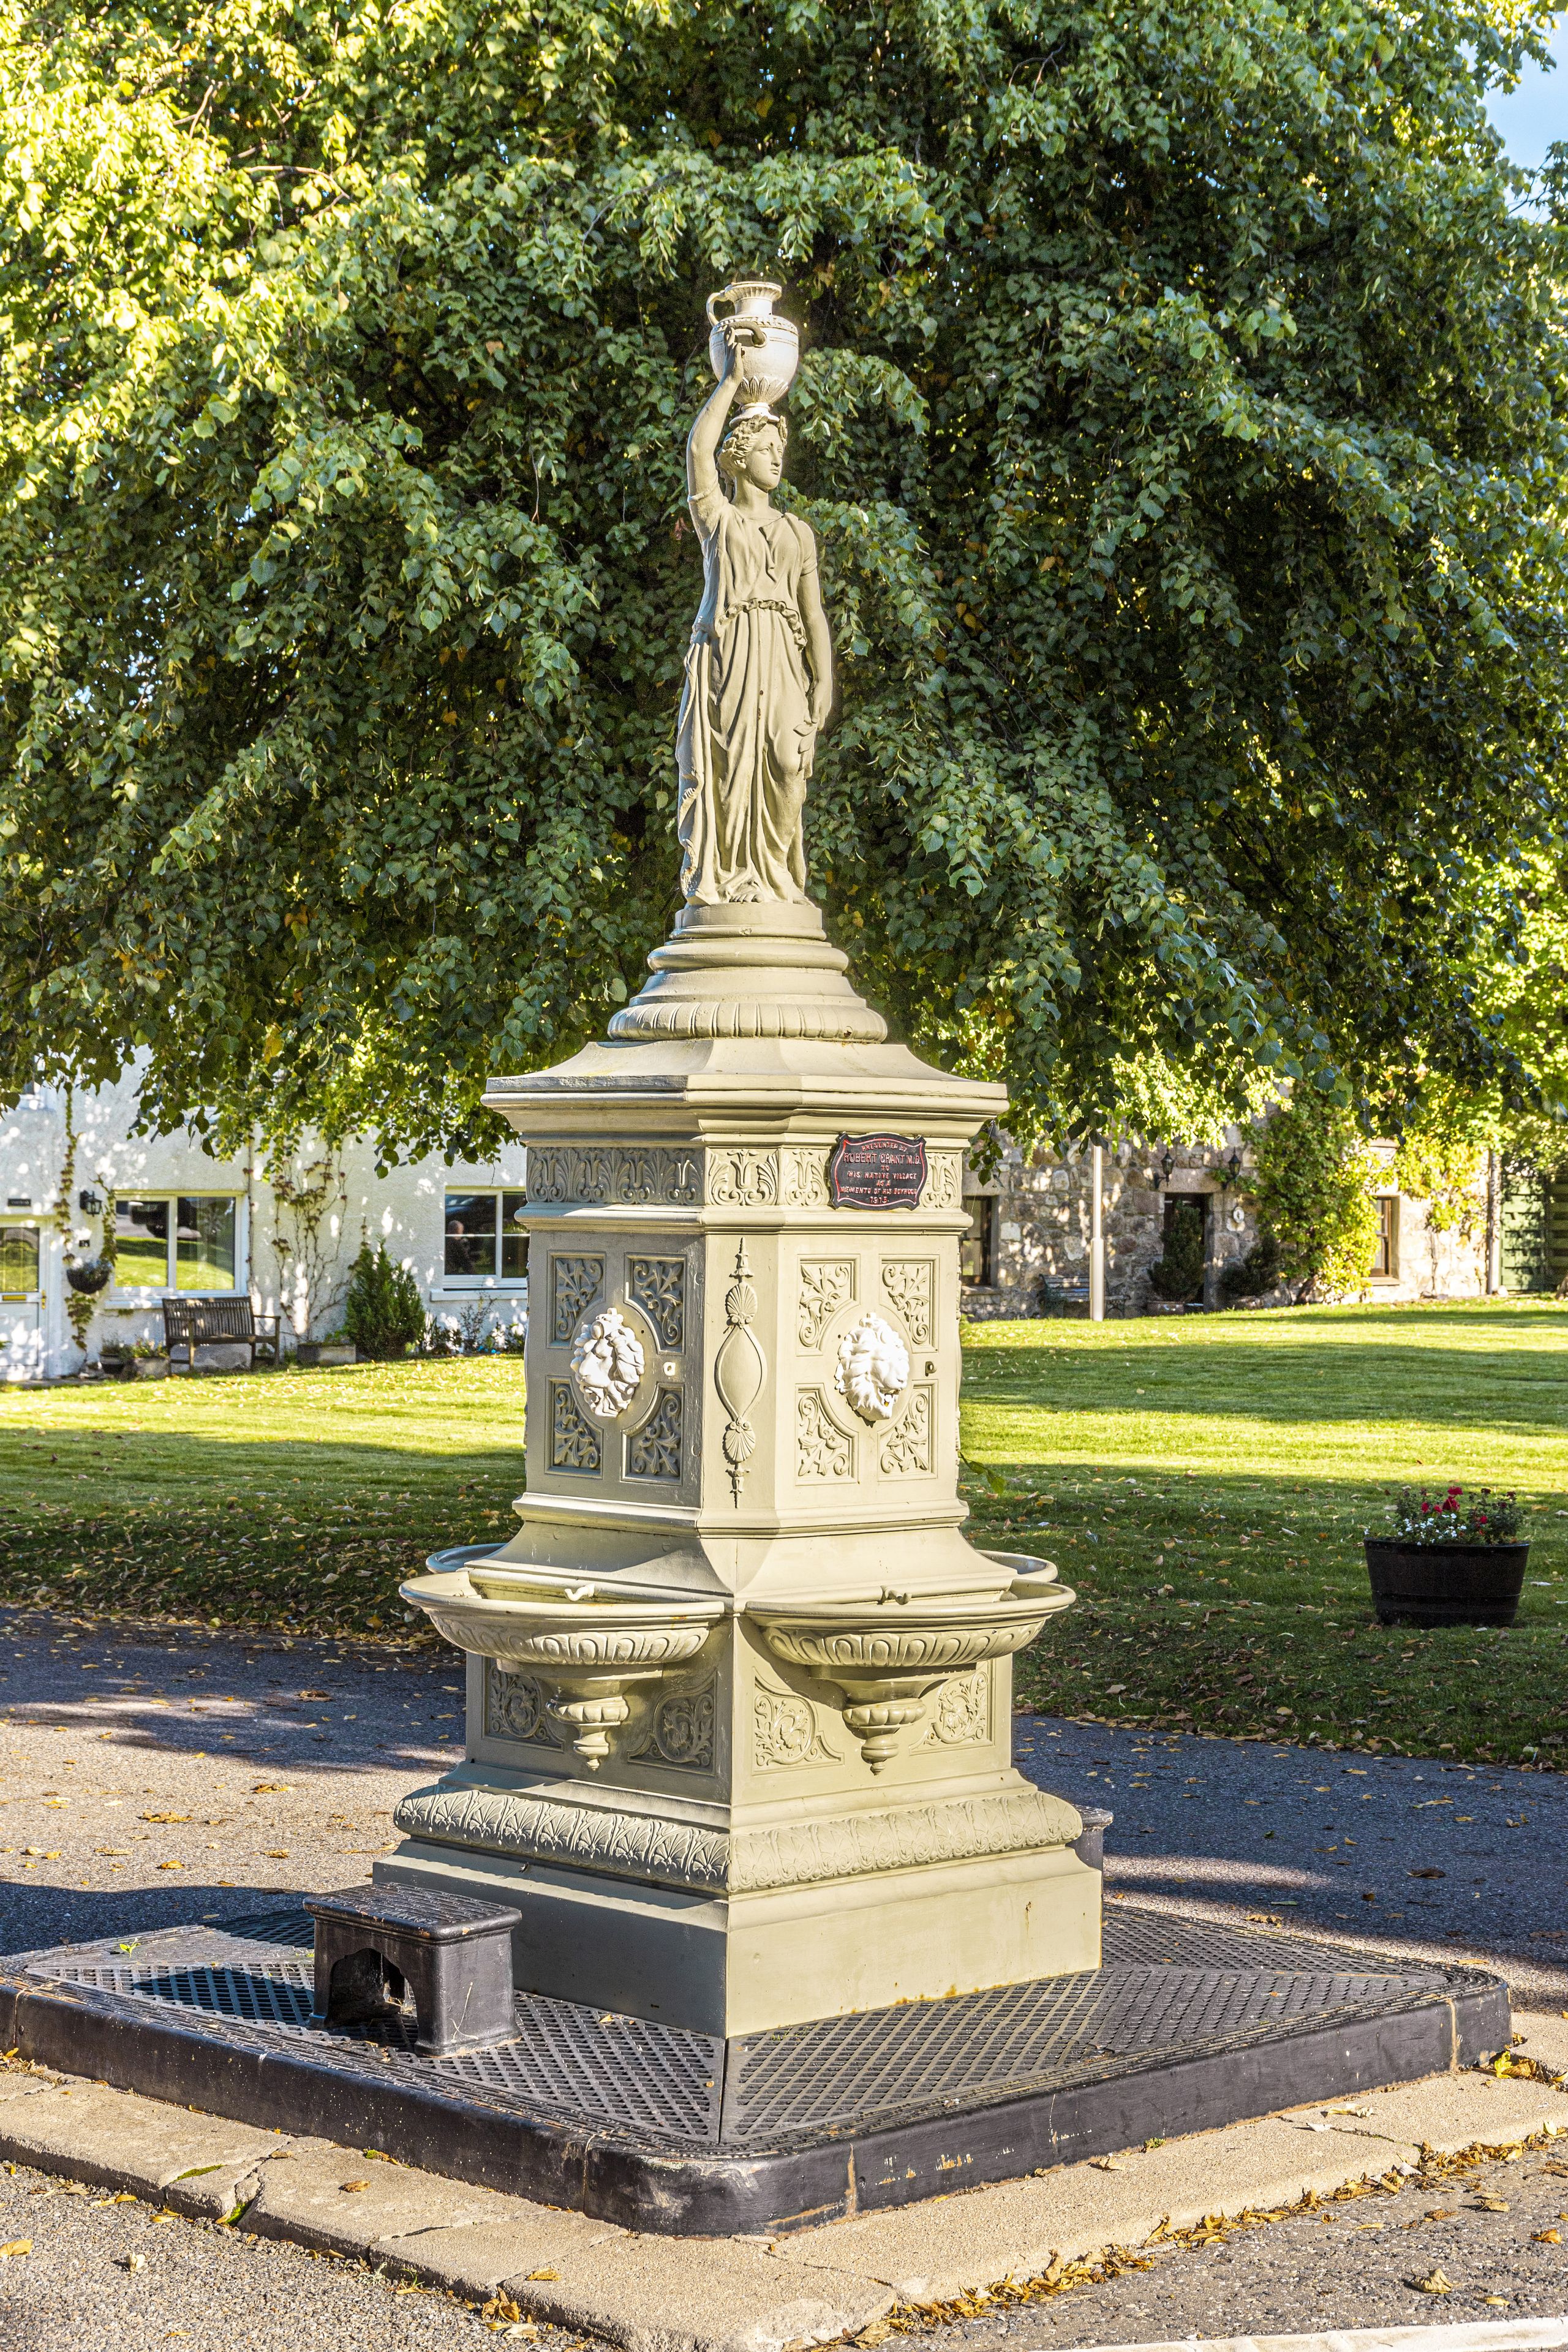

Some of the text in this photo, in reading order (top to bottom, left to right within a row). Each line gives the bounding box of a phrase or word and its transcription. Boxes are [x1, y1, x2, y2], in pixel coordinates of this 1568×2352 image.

[862, 1142, 897, 1152] PRESENTED
[843, 1152, 877, 1163] ROBERT
[880, 1153, 905, 1164] GRANT
